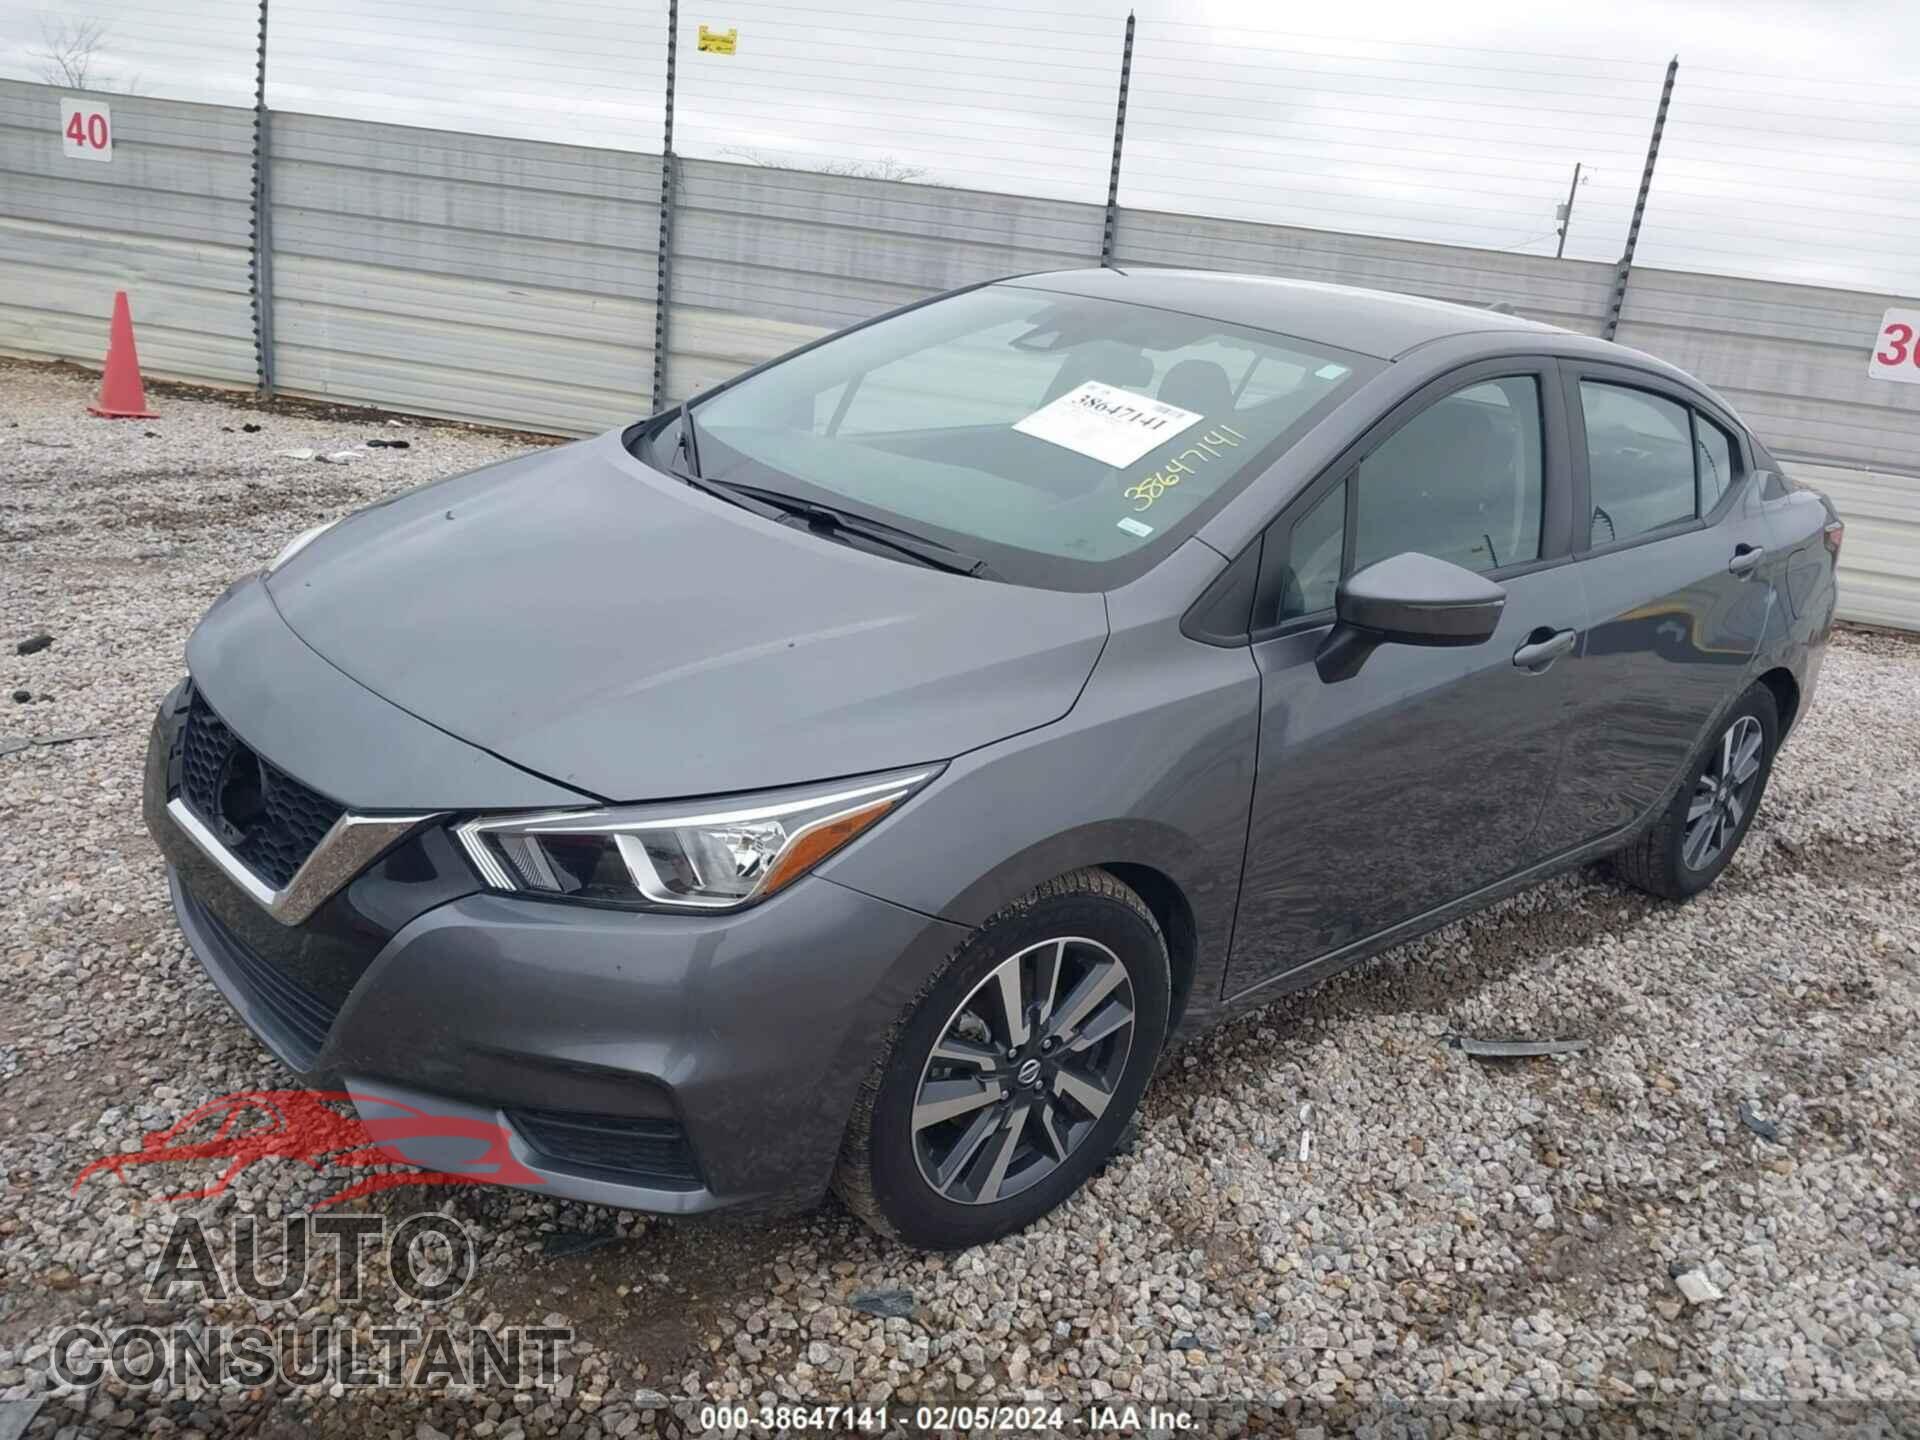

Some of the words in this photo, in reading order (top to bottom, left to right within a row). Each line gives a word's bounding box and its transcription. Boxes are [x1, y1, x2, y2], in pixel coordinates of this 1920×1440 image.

[66, 111, 108, 150] 40
[1876, 323, 1920, 369] 3
[1078, 393, 1168, 431] 38647141
[1123, 424, 1247, 512] 38647141
